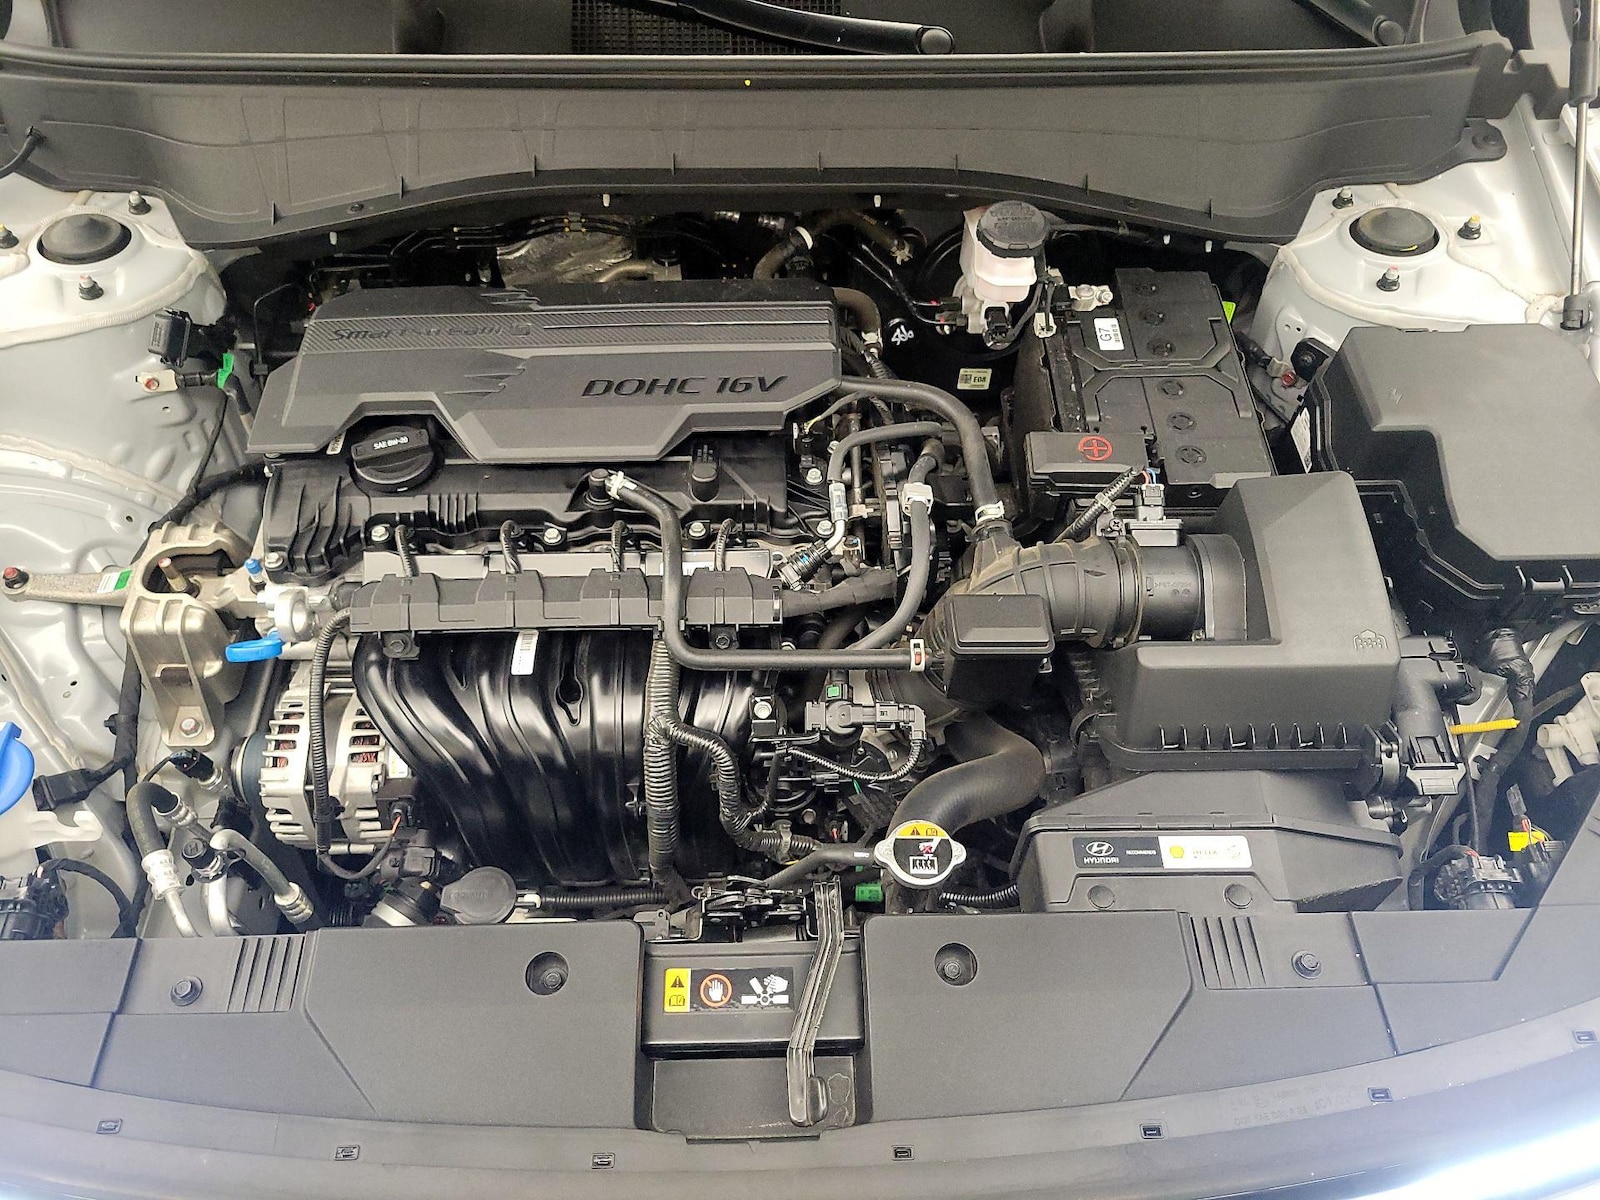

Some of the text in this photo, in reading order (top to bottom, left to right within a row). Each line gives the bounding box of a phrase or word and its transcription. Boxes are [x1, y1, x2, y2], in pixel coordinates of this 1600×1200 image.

[1098, 327, 1113, 342] G7
[581, 375, 789, 398] DOHC 16V
